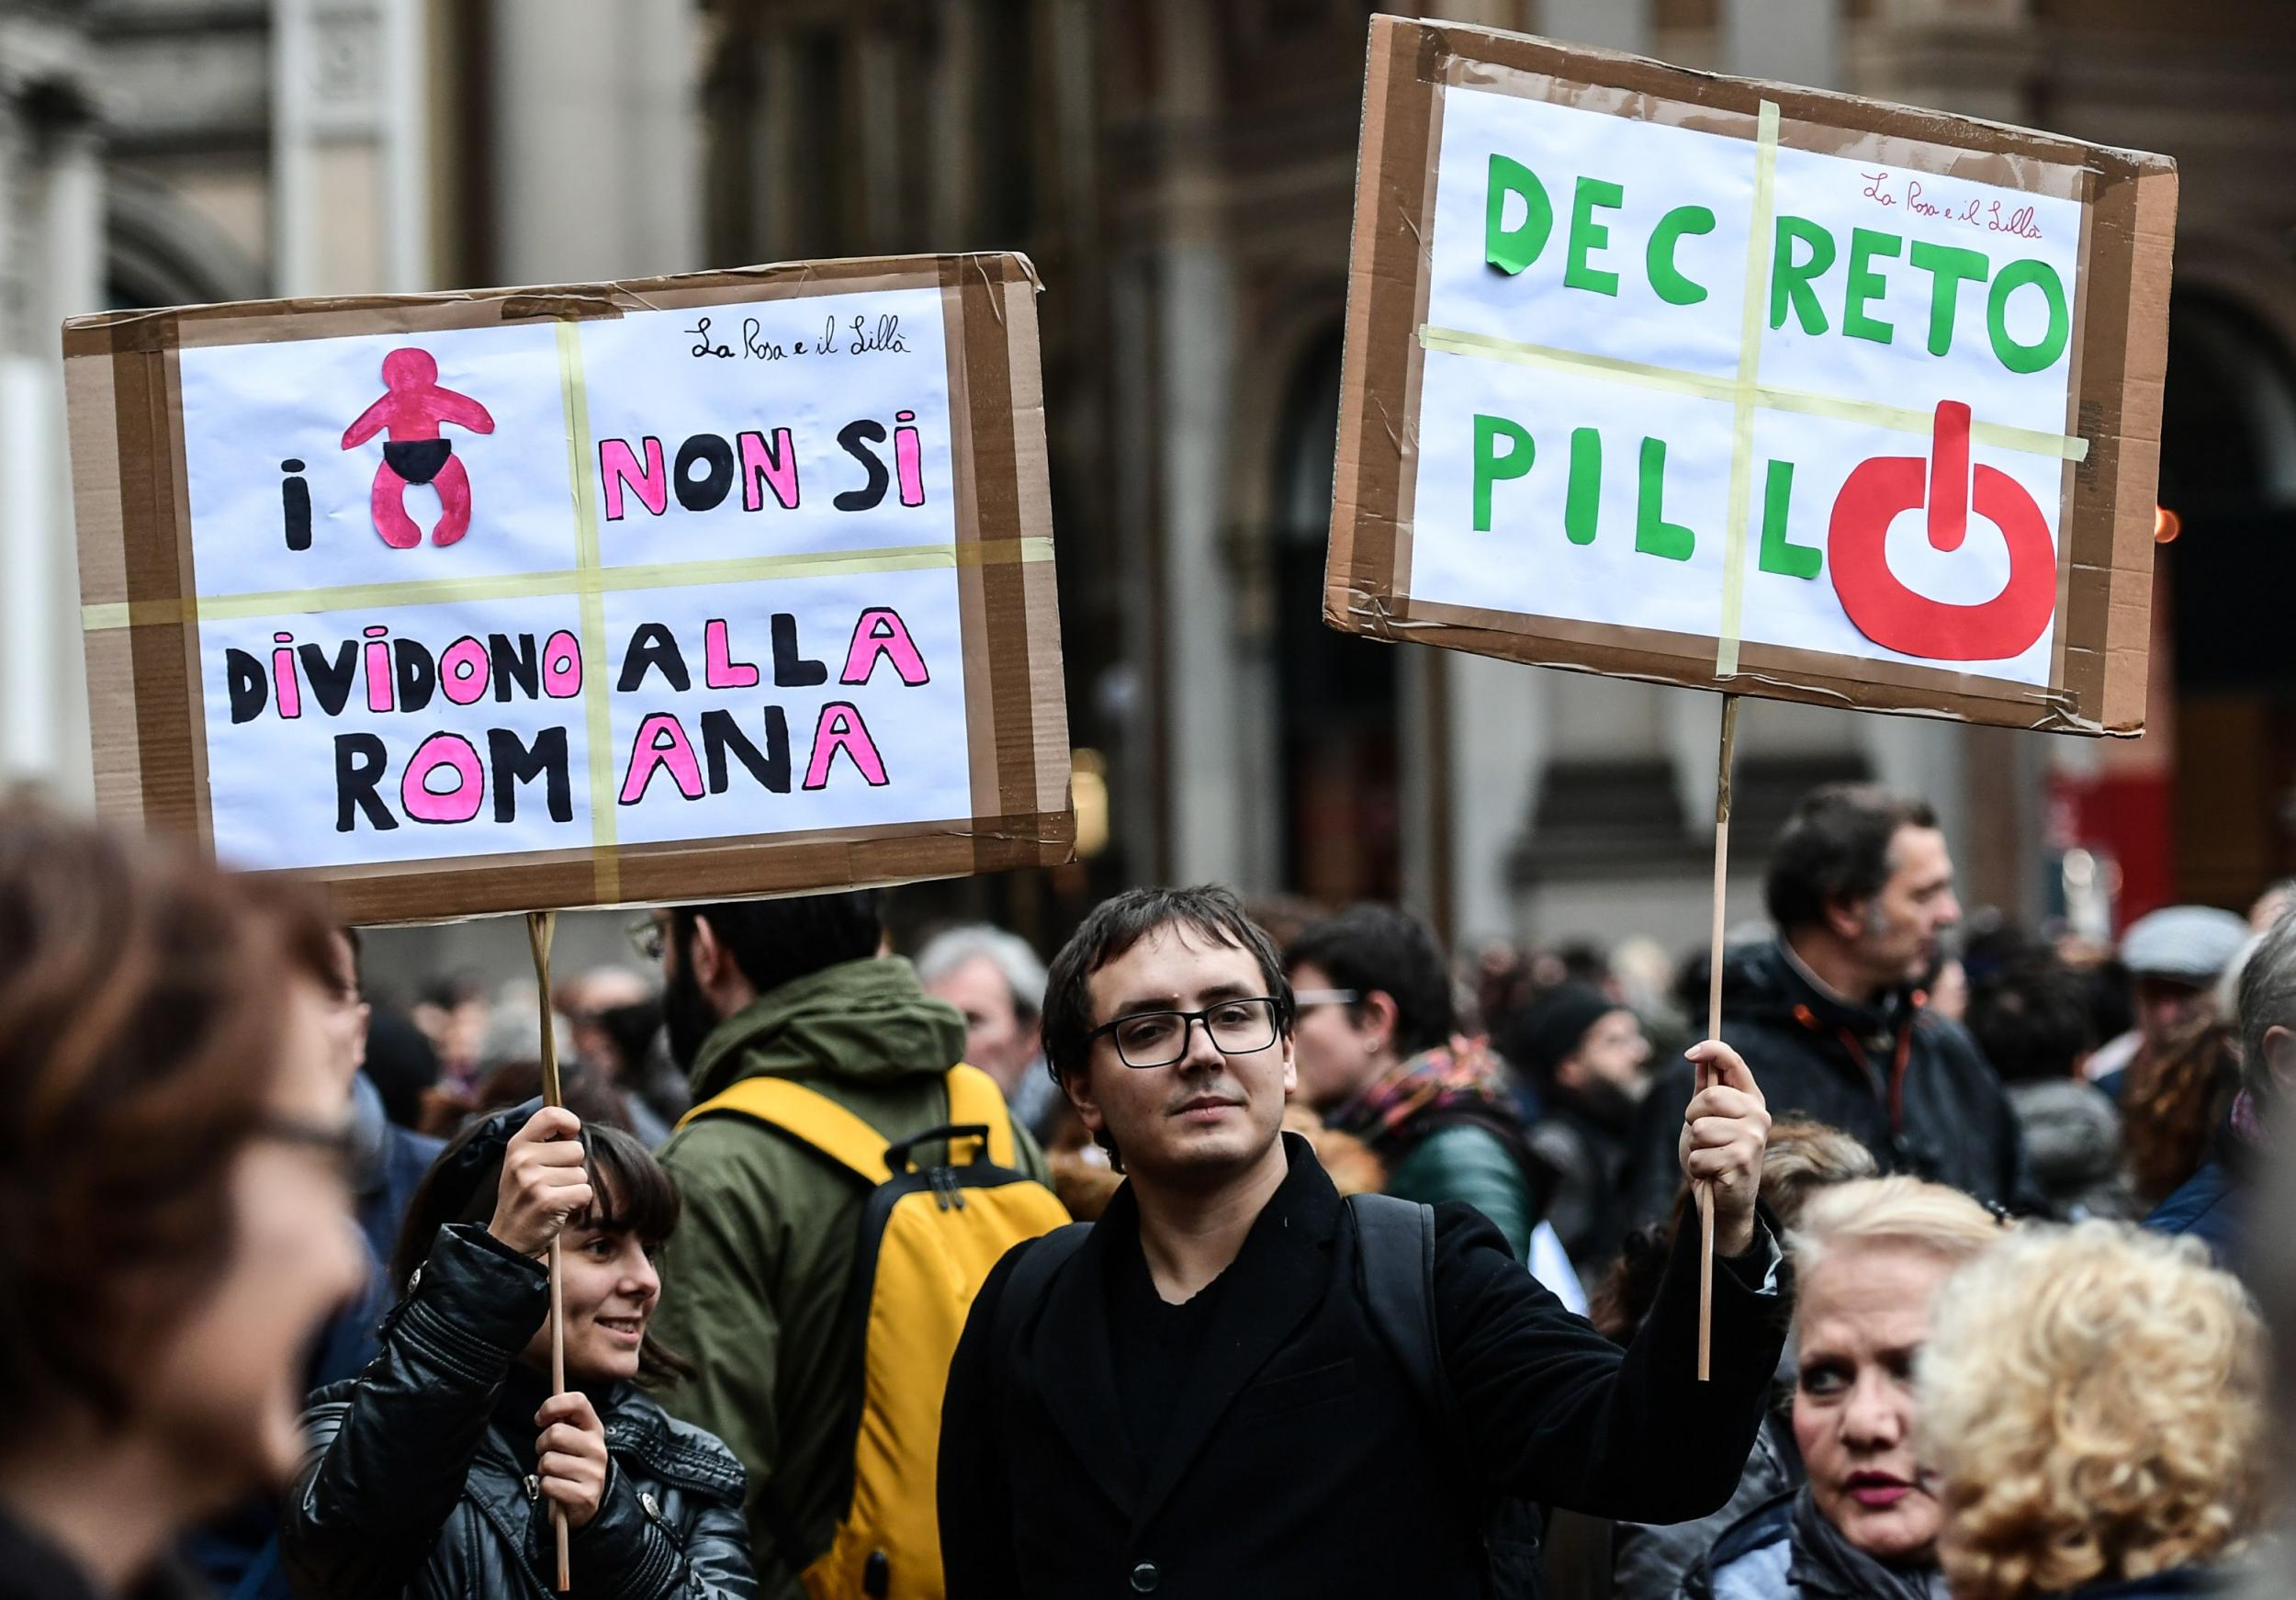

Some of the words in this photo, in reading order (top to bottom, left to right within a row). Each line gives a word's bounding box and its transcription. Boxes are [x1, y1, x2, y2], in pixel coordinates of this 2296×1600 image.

[1861, 173, 1896, 206] La
[1907, 181, 1940, 216] Rosa
[1943, 208, 1953, 220] e
[1957, 198, 1980, 225] il
[1486, 154, 2069, 374] DECRETO
[684, 317, 736, 358] La
[743, 318, 788, 360] Rosa
[793, 342, 808, 355] e
[815, 315, 838, 355] il
[599, 427, 801, 522] NON
[617, 606, 930, 693] ALLA
[333, 701, 891, 832] ROMANA
